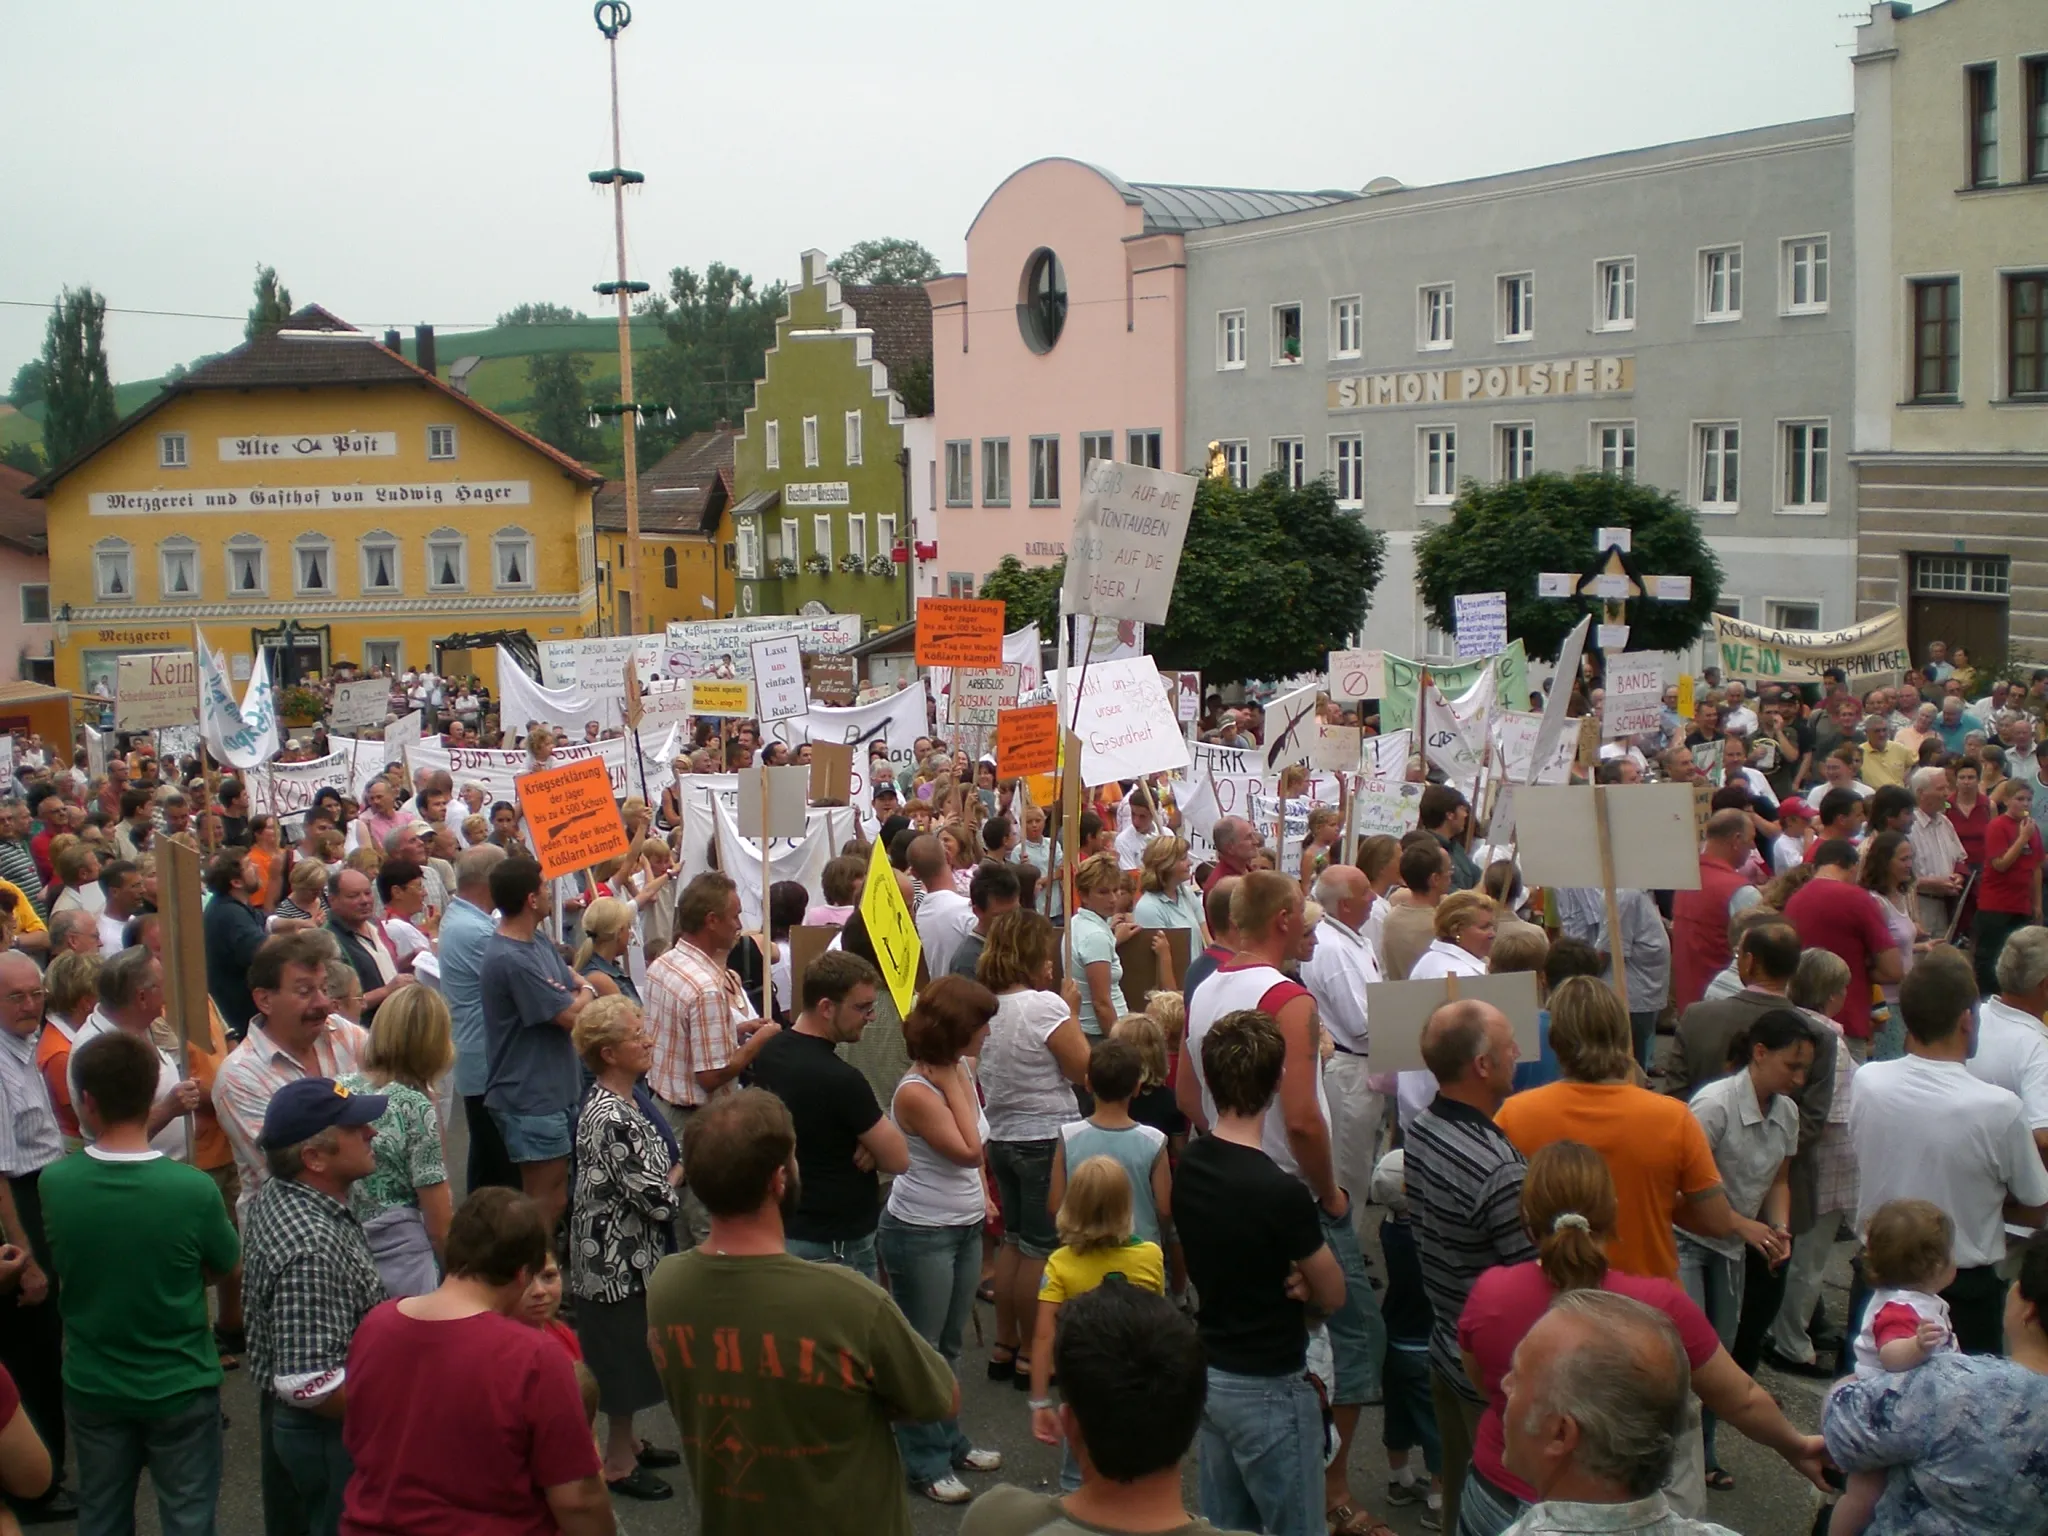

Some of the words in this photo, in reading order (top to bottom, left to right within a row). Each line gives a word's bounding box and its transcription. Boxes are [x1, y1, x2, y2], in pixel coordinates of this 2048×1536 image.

[1338, 372, 1448, 408] SIMON
[1462, 357, 1624, 400] POLSTER
[236, 439, 280, 457] Alte
[332, 435, 379, 457] Post
[107, 493, 194, 512] Metzgerei
[206, 492, 237, 506] und
[250, 489, 320, 509] Gasthof
[332, 488, 363, 502] von
[376, 486, 442, 503] Ludwig
[1131, 484, 1157, 502] AUF
[1160, 491, 1181, 511] DIE
[1100, 507, 1171, 538] TONTAUBEN
[1025, 541, 1066, 556] RATHAUS
[1114, 548, 1141, 566] AUF
[1144, 553, 1164, 571] DIE
[98, 629, 171, 645] Metzgerei
[765, 646, 787, 657] Lasst
[149, 655, 193, 686] Kein
[765, 675, 796, 688] einfach
[1617, 672, 1657, 694] BANDE
[1614, 713, 1660, 731] SCHANDE
[1090, 720, 1153, 755] Gesundheit
[1194, 746, 1247, 773] HERR
[524, 767, 601, 796] Kriegserklärung
[549, 794, 563, 804] der
[565, 788, 585, 801] Jäger
[534, 814, 547, 824] bis
[548, 811, 559, 819] zu
[581, 796, 608, 810] Schuss
[539, 839, 561, 855] jeden
[562, 834, 579, 845] Tag
[579, 828, 593, 839] der
[595, 821, 618, 835] Woche
[547, 847, 587, 868] Kößlarn
[586, 834, 622, 855] kämpft
